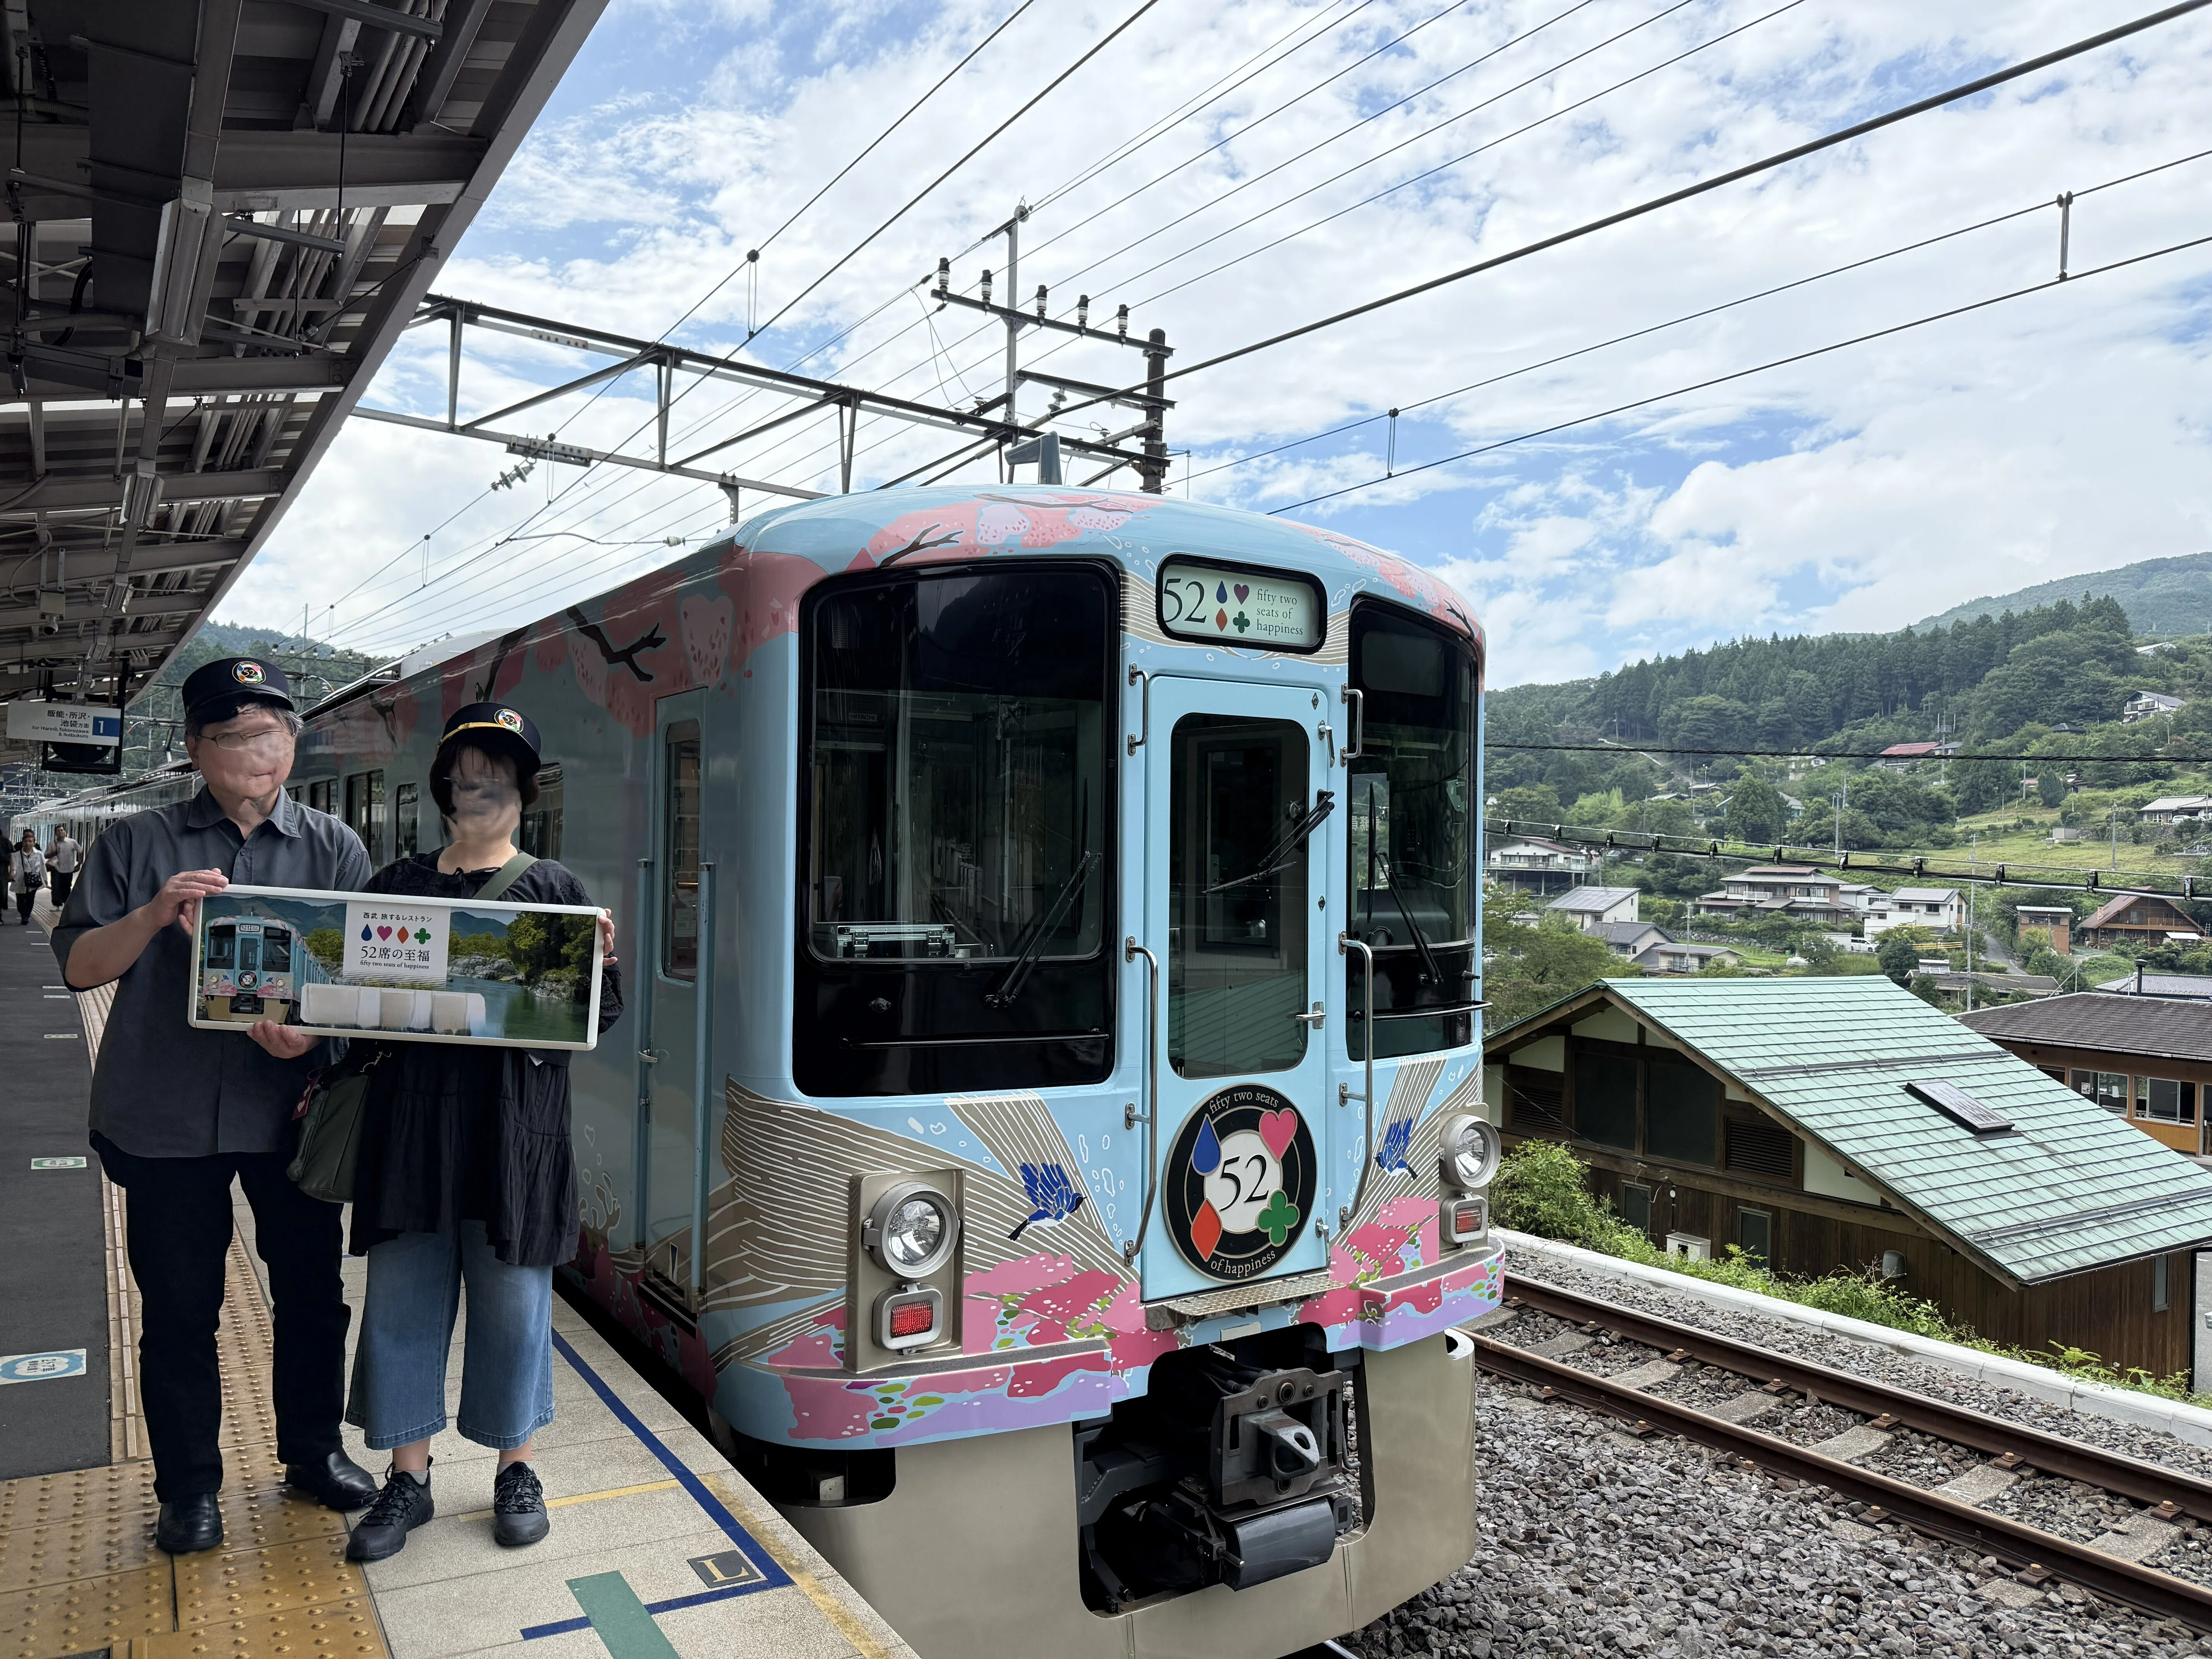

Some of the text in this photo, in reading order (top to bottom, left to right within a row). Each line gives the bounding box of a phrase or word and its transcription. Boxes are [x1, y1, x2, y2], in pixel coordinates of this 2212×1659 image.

[1163, 578, 1207, 623] 52
[1257, 589, 1297, 605] fifty two
[1257, 606, 1293, 619] seats of
[1257, 619, 1303, 636] happiness
[60, 720, 89, 728] 池袋方面
[98, 721, 104, 733] 1
[505, 716, 515, 725] 52
[381, 913, 432, 922] 旅するレストラン
[361, 946, 430, 962] 52席の至福
[1209, 1092, 1279, 1114] fifty two seats
[1219, 1154, 1269, 1211] 52
[1211, 1250, 1276, 1277] of happiness
[697, 1557, 749, 1582] L
